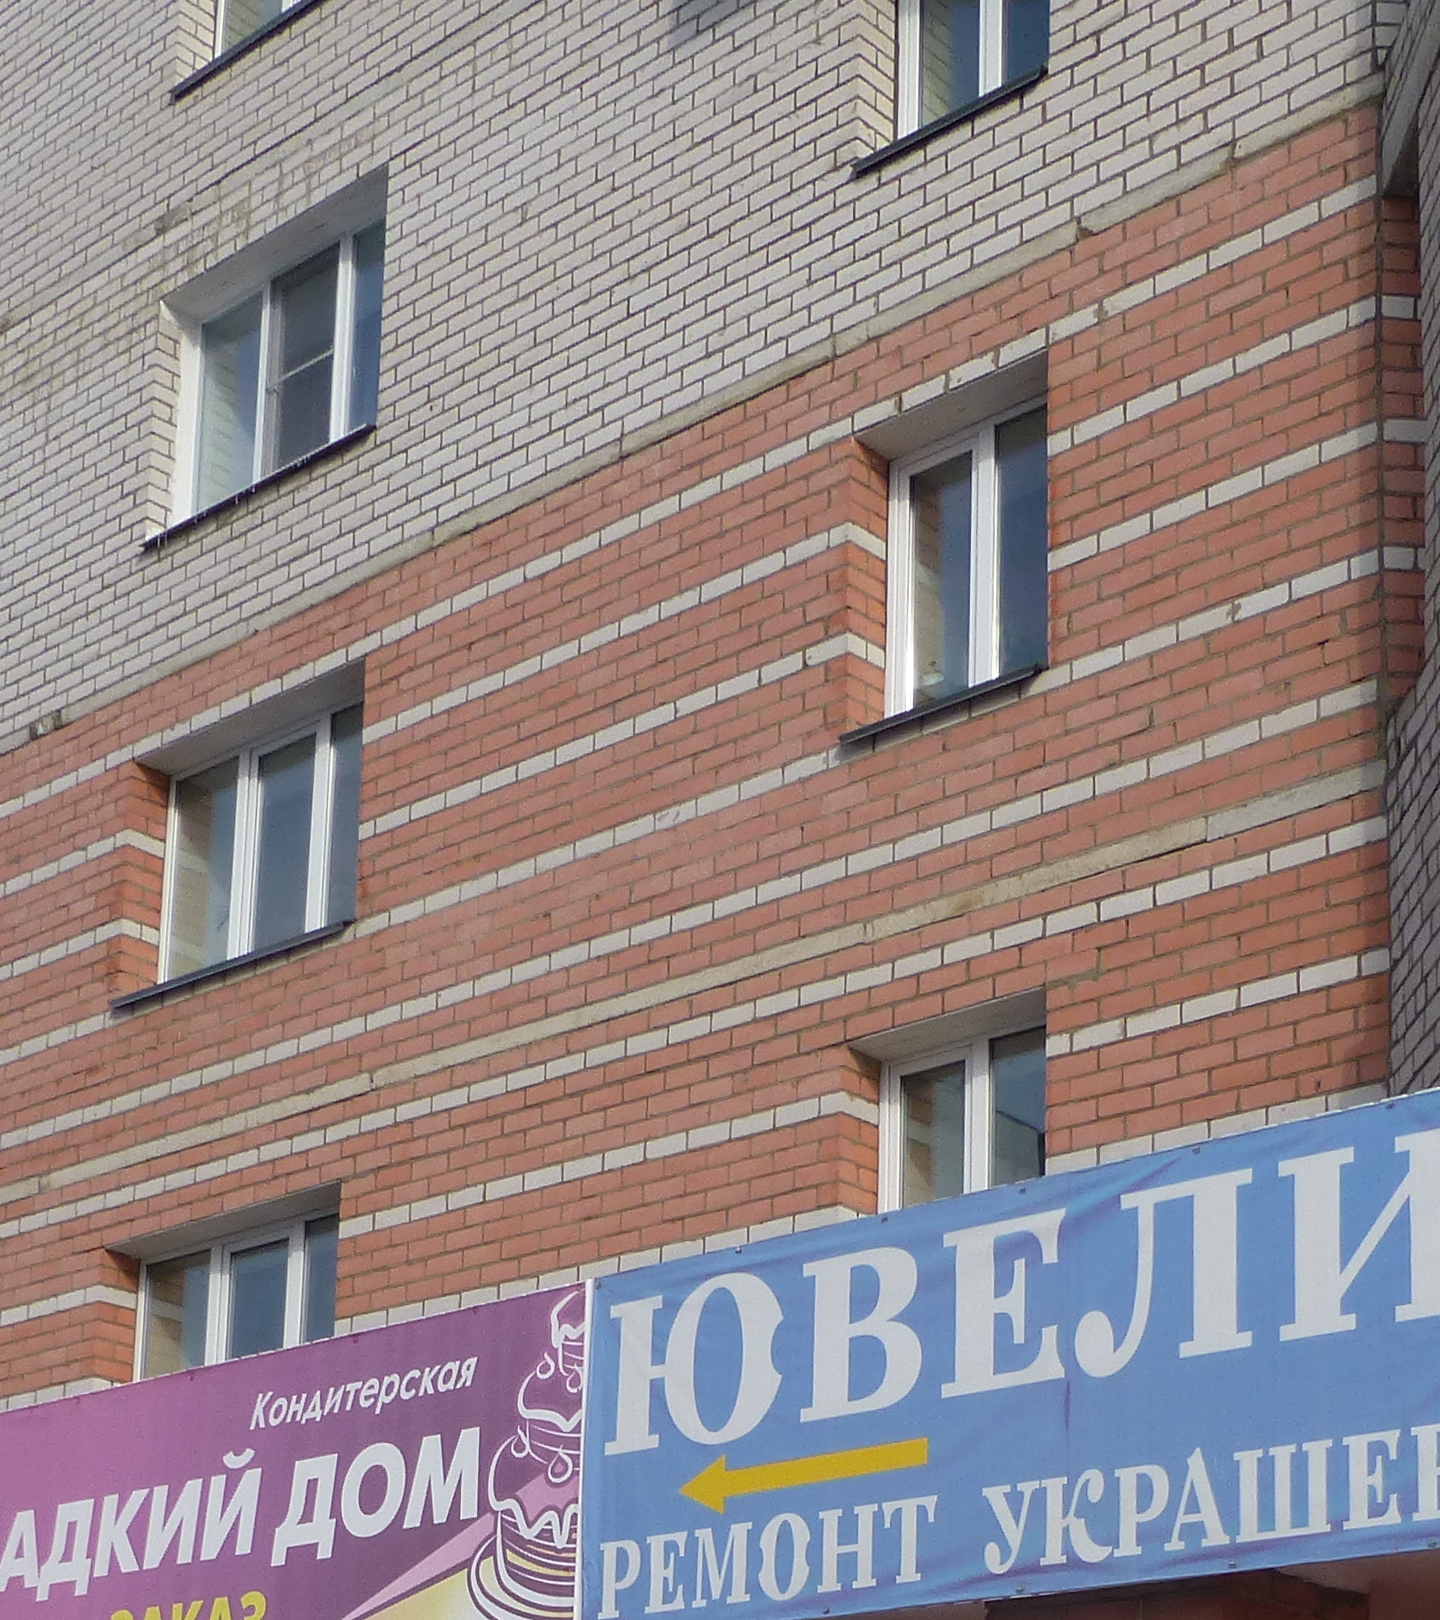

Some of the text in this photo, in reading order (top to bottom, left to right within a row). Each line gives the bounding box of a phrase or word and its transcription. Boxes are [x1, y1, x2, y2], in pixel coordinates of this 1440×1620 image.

[249, 1355, 478, 1432] Кондитерская
[271, 1427, 481, 1567] ДОМ
[597, 1494, 938, 1620] РЕМОНТ
